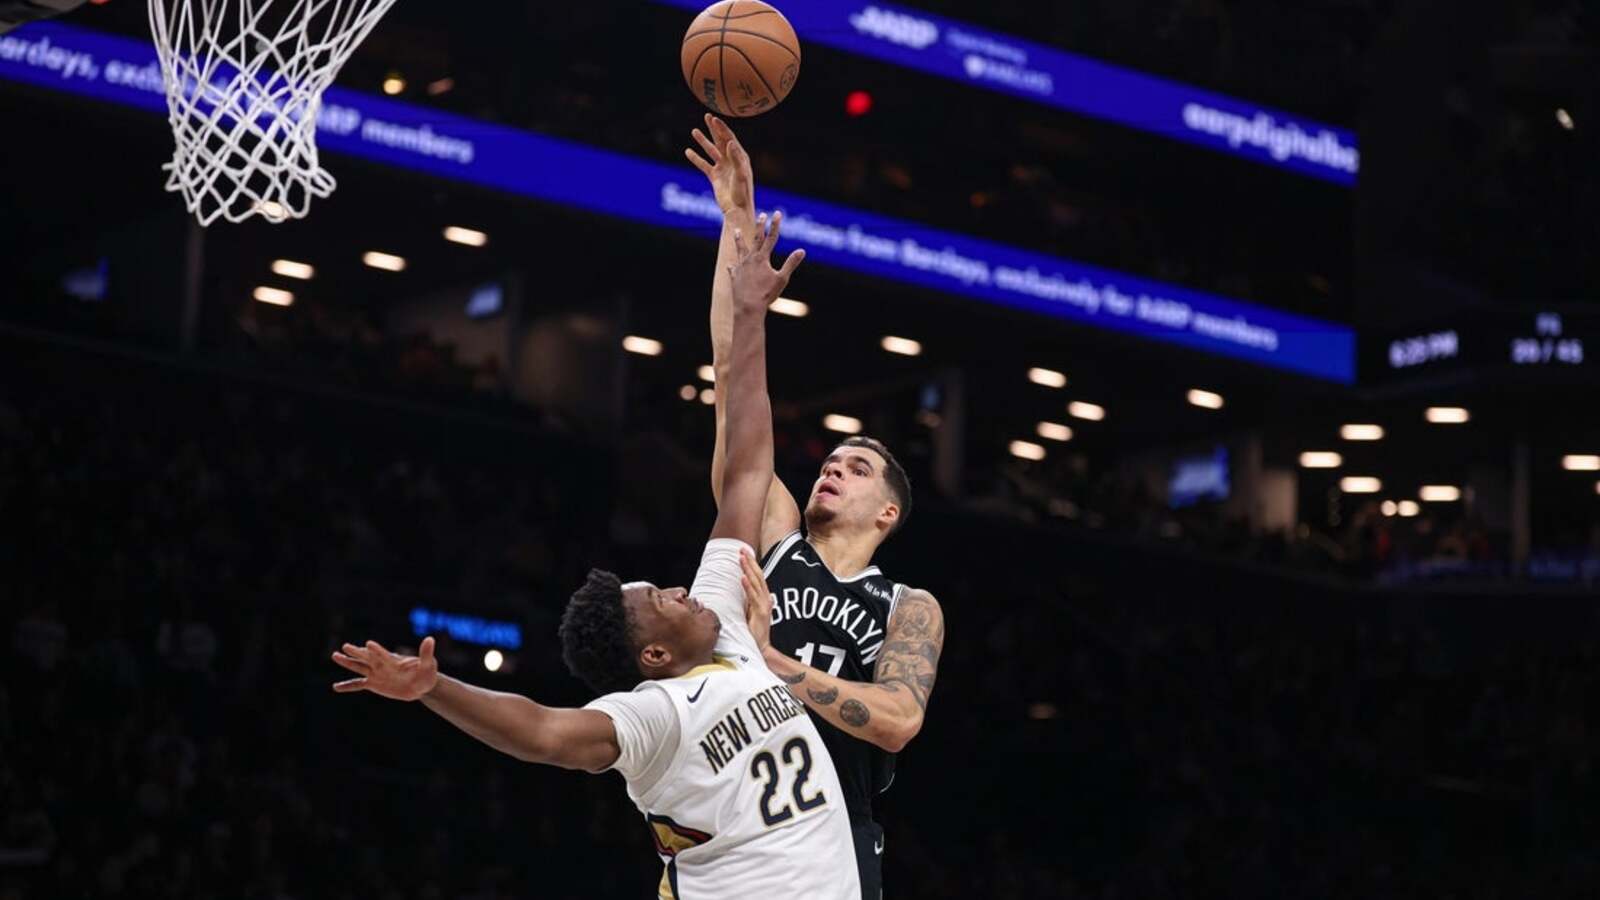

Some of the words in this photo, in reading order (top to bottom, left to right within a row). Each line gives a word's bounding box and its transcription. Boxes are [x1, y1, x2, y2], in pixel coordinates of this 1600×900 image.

[0, 37, 98, 80] arclays,
[361, 119, 475, 164] members
[770, 586, 884, 666] BROOKLYN
[795, 642, 847, 678] 17
[699, 707, 753, 776] NEW
[750, 736, 827, 827] 22
